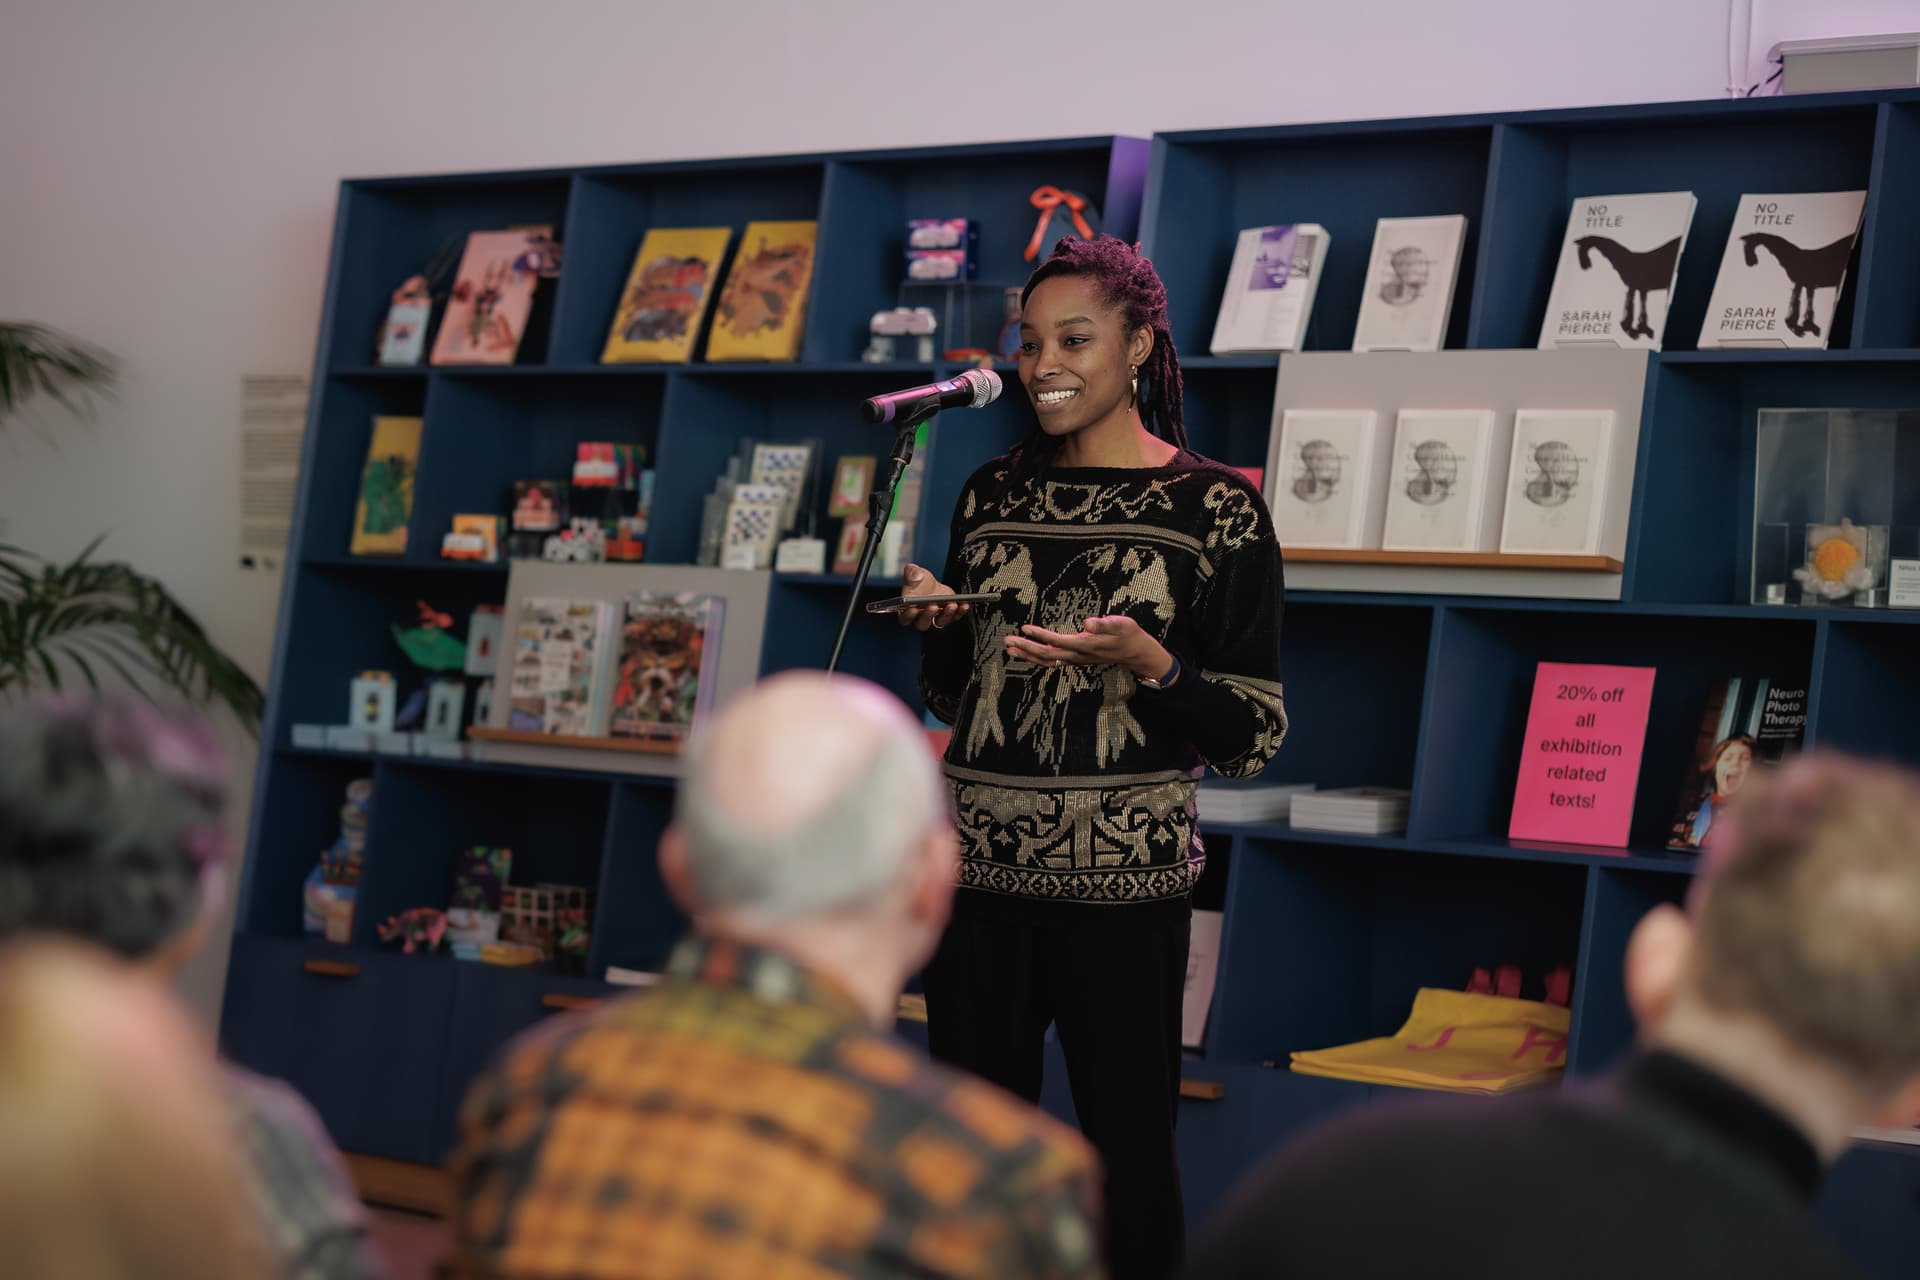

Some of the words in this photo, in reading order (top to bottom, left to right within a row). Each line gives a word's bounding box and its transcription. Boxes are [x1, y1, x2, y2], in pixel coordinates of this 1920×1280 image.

[1587, 205, 1608, 216] NO
[1756, 202, 1778, 213] NO
[1586, 215, 1624, 228] TITLE
[1753, 214, 1794, 225] TITLE
[1562, 310, 1612, 321] SARAH
[1723, 307, 1776, 318] SARAH
[1559, 322, 1612, 334] PIERCE
[1720, 319, 1776, 330] PIERCE
[1557, 684, 1597, 701] 20%
[1601, 687, 1625, 703] off
[1769, 687, 1805, 700] Neuro
[1766, 700, 1801, 712] Photo
[1576, 713, 1596, 728] all
[1540, 737, 1622, 756] exhibition
[1547, 765, 1606, 782] related
[1549, 791, 1596, 809] texts!
